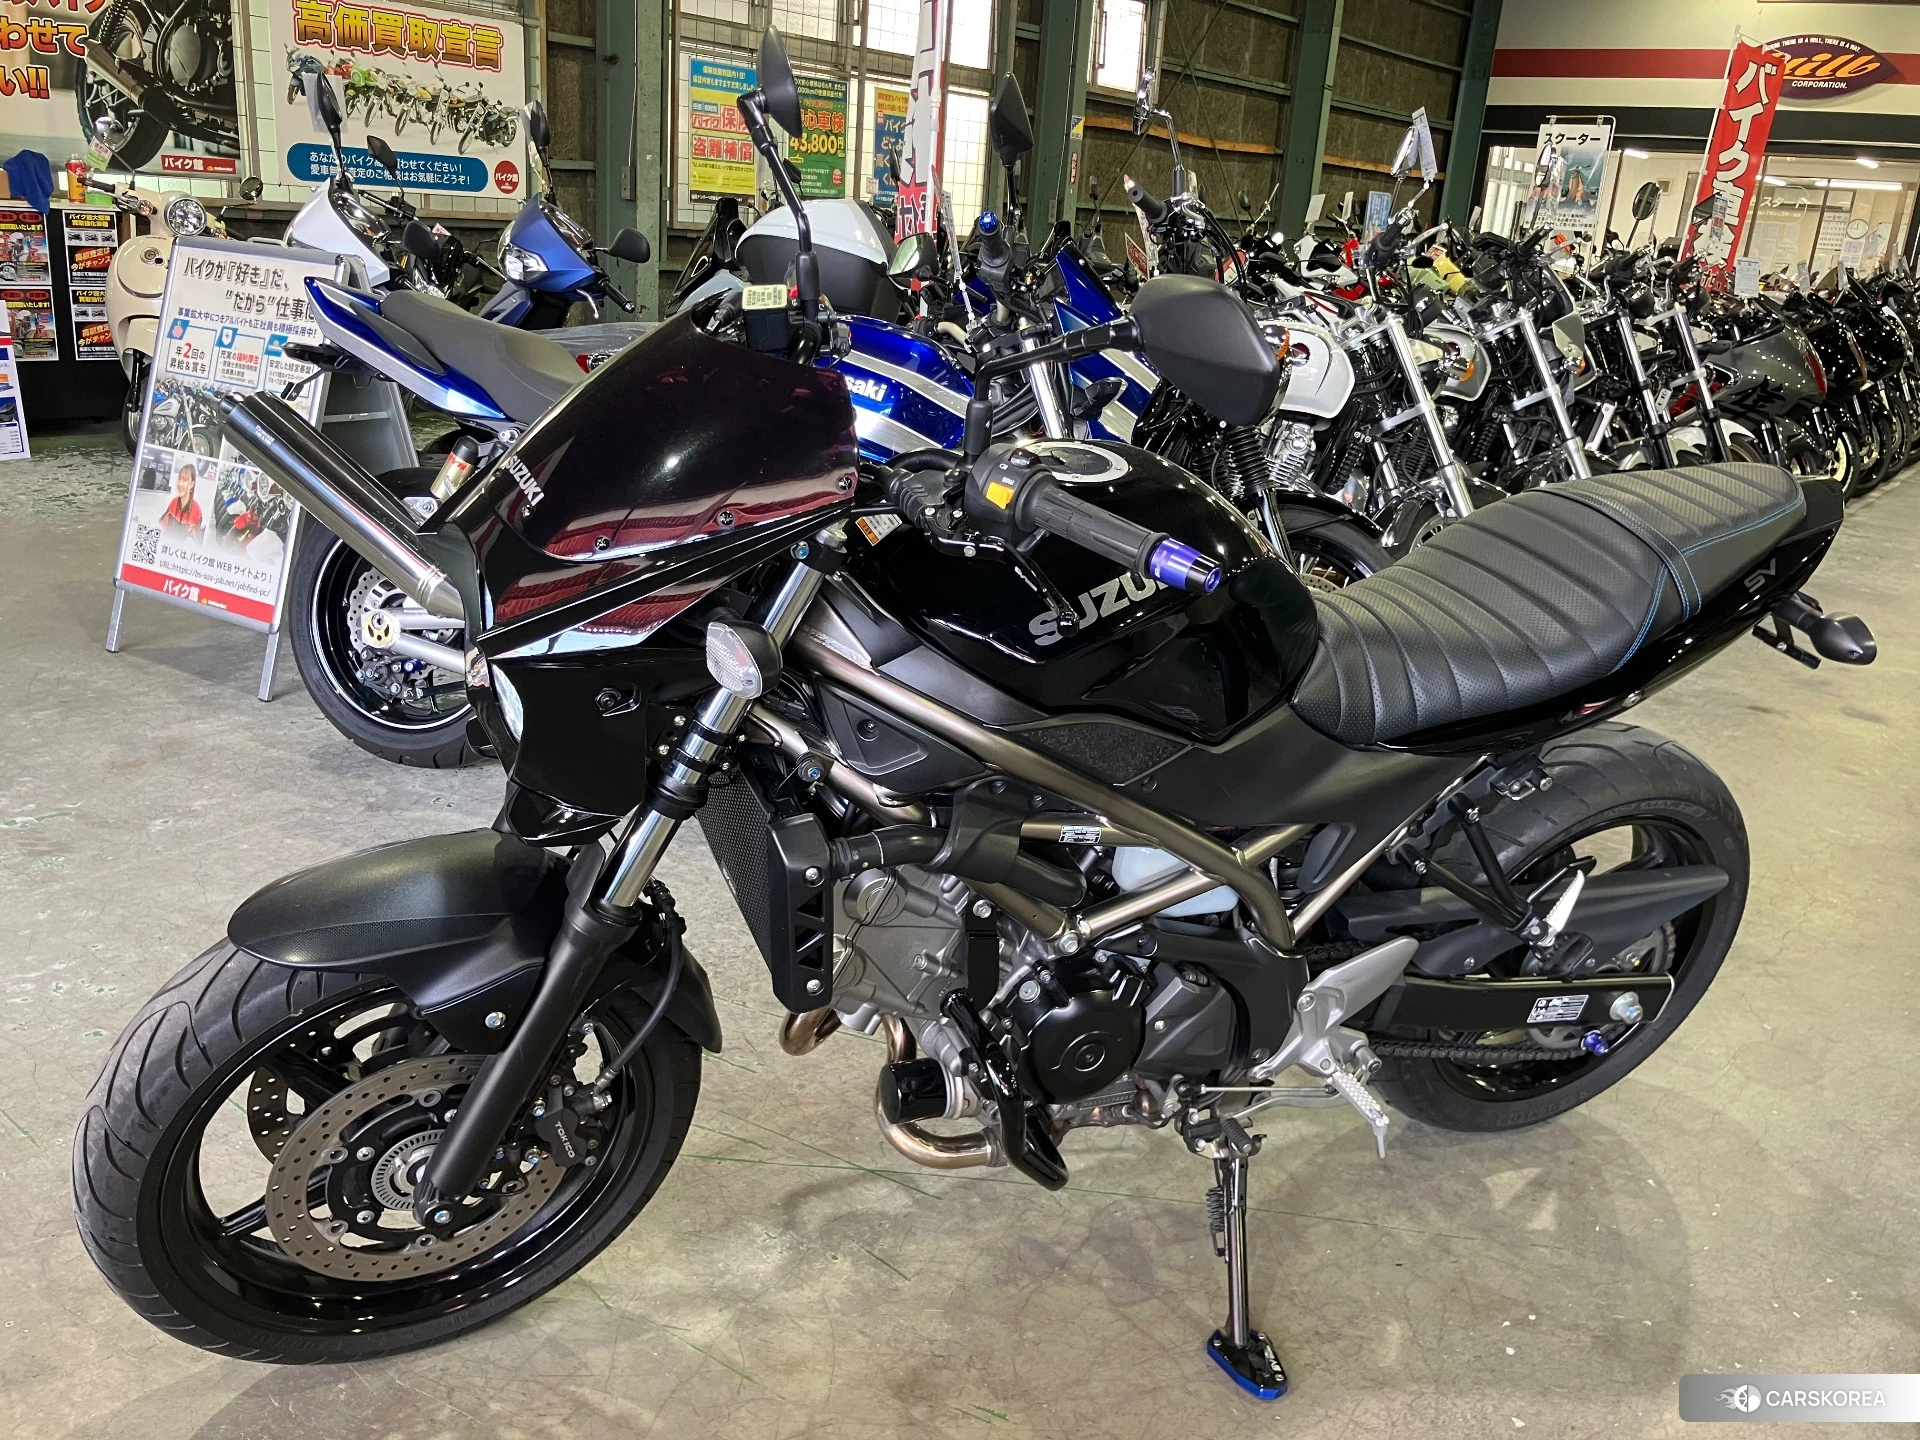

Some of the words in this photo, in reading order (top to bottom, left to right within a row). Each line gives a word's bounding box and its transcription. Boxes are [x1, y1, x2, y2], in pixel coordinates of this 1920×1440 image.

[295, 0, 503, 71] 高価買取宣言
[1791, 80, 1848, 89] CORPORATION.
[801, 108, 845, 134] 心車検
[693, 136, 754, 163] 盗難補償
[1543, 132, 1601, 145] スクーター
[164, 157, 204, 171] バイク館
[175, 342, 206, 360] 年2回の
[220, 350, 260, 365] 充実の福利厚生
[169, 361, 207, 375] 昇給&賞与
[506, 455, 545, 507] SUZUKI
[216, 561, 232, 572] WEB
[1743, 558, 1777, 594] SV
[163, 579, 200, 604] バイク館
[1029, 572, 1170, 646] SUZU
[554, 1120, 576, 1159] TOKICO
